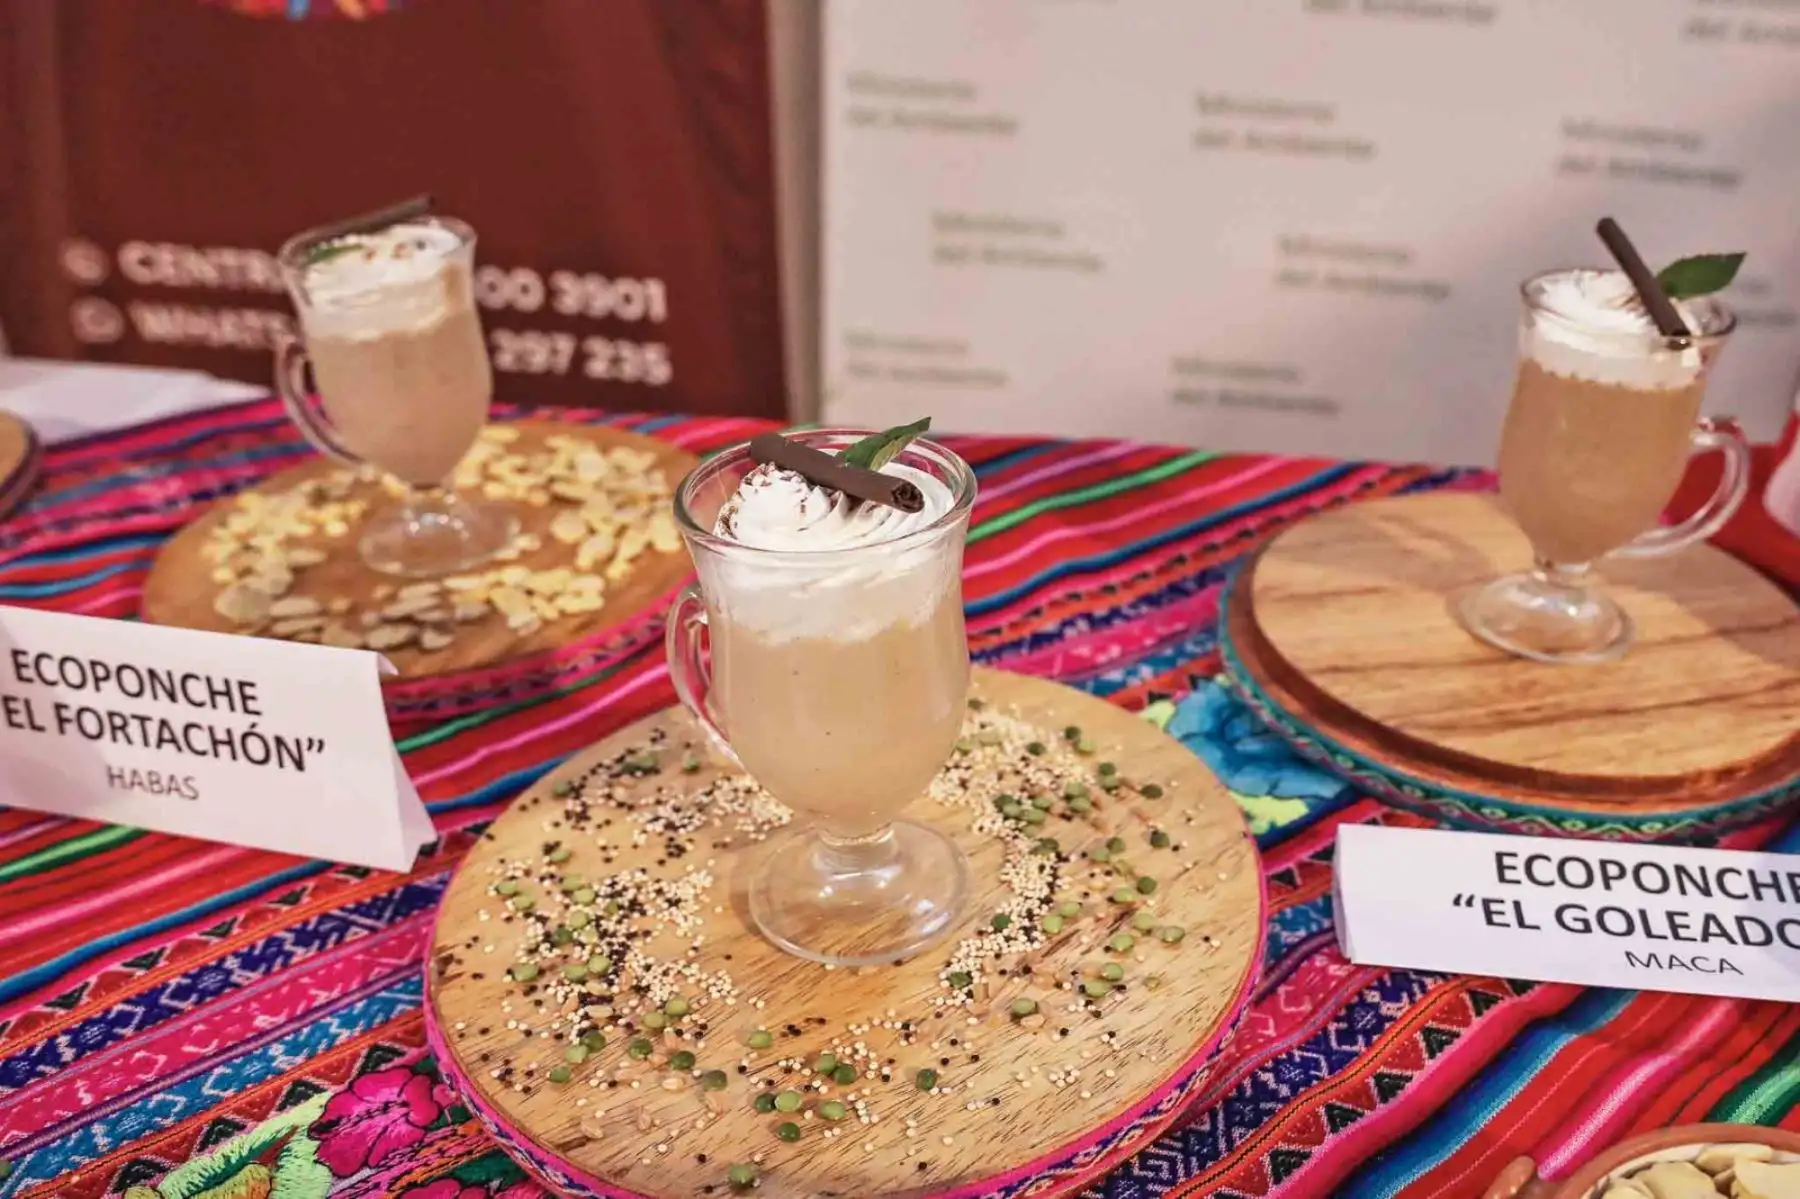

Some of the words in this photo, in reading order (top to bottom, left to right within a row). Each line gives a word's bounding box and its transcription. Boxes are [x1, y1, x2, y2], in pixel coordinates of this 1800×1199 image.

[117, 240, 286, 292] CENTR
[582, 334, 673, 386] 235
[11, 649, 263, 716] ECOPONCHE
[2, 695, 46, 733] EL
[107, 765, 200, 801] HABAS
[1625, 951, 1744, 976] MACA
